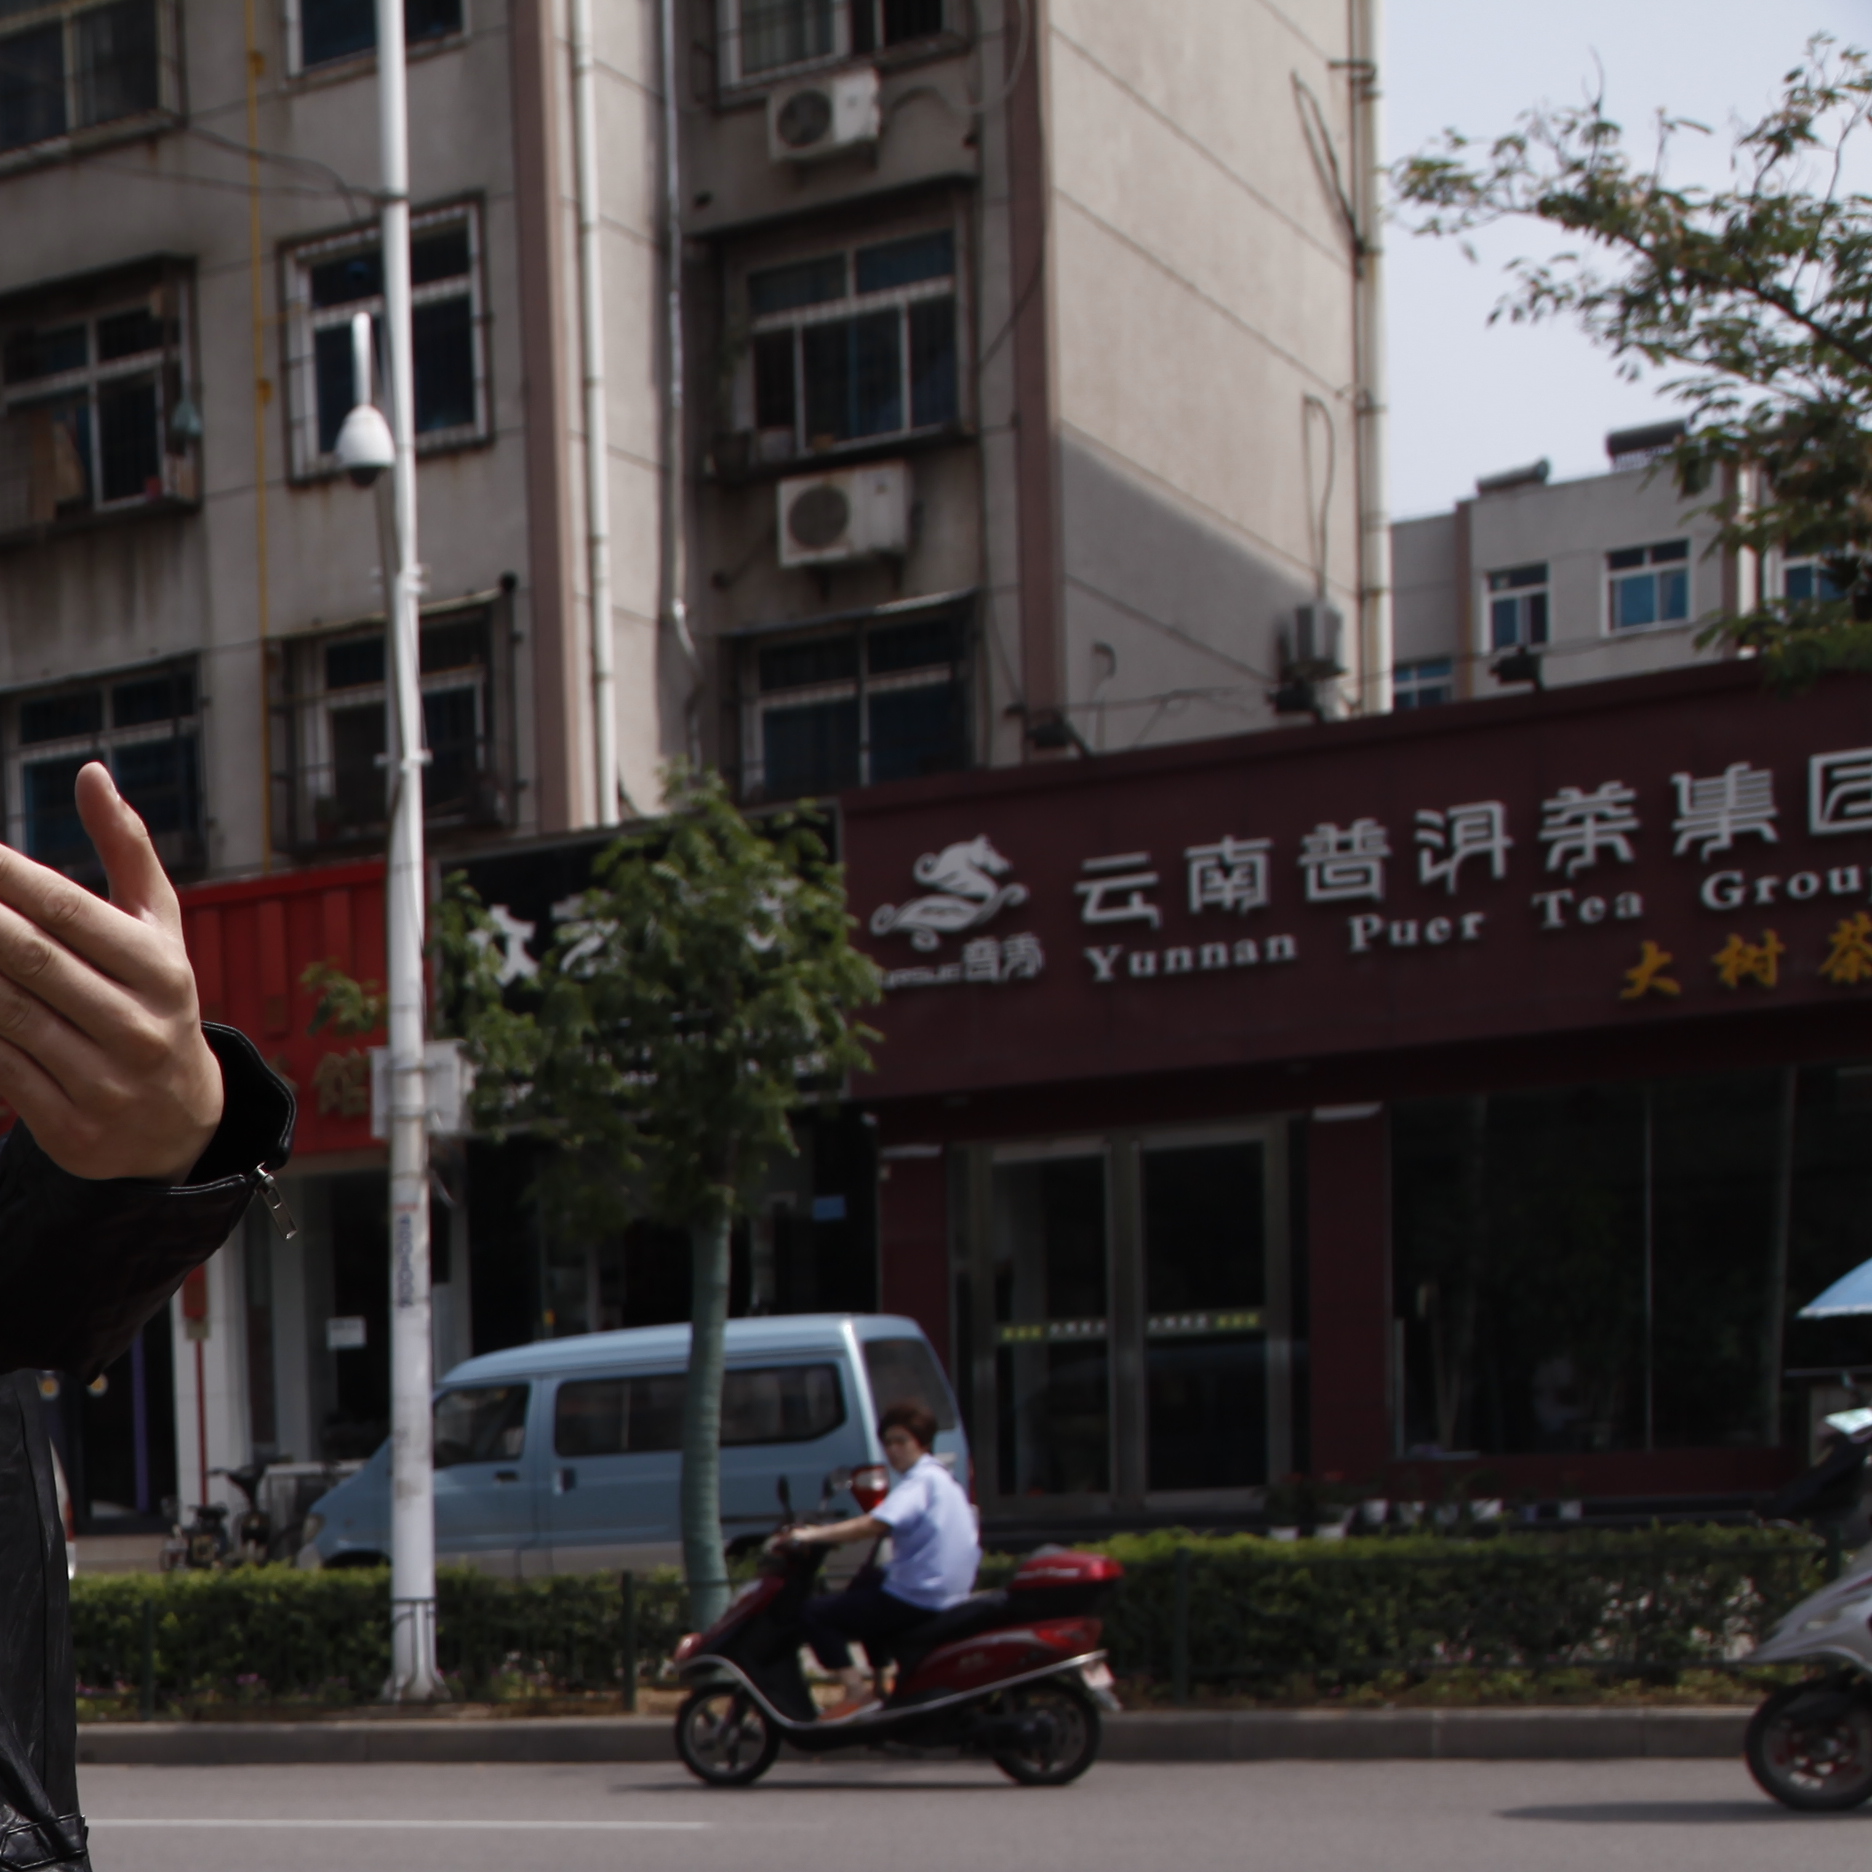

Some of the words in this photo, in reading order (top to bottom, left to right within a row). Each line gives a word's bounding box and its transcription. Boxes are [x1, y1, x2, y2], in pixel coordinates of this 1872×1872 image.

[1084, 933, 1298, 982] Yunnan
[1347, 911, 1486, 953] Puer
[1531, 887, 1645, 930] Tea
[1700, 862, 1872, 911] Grou
